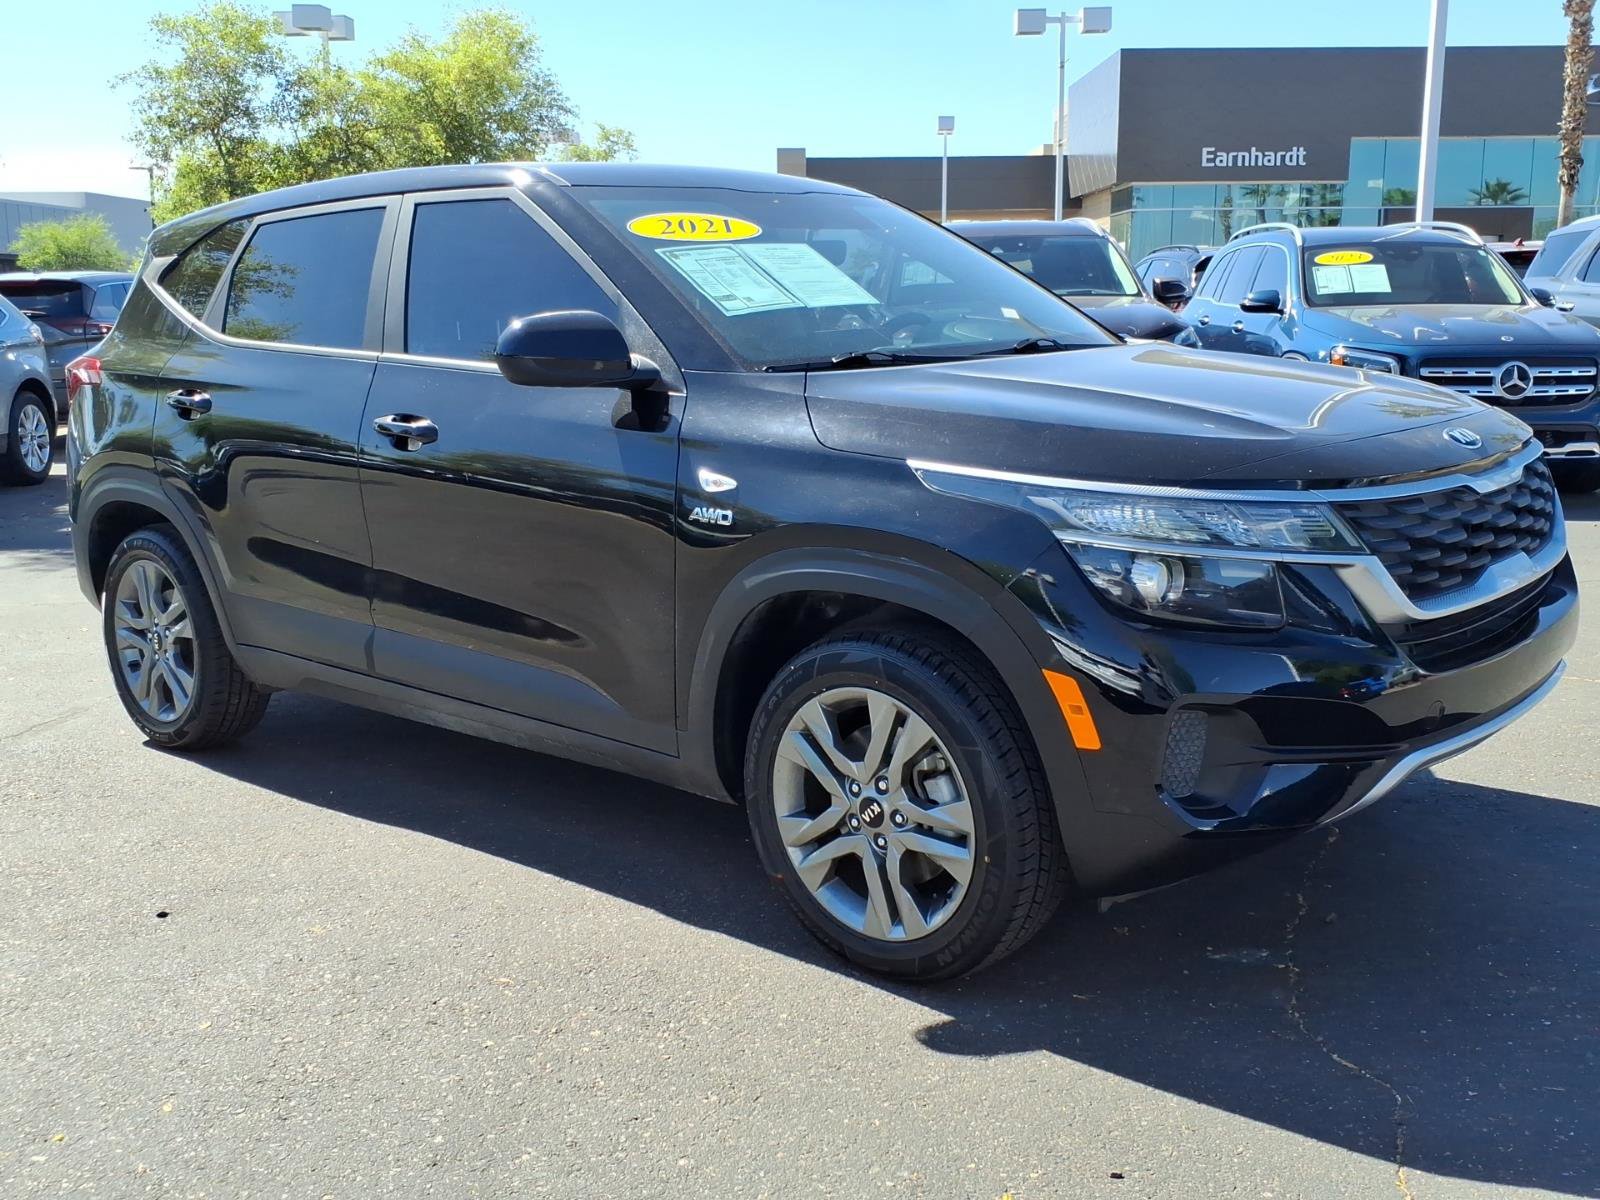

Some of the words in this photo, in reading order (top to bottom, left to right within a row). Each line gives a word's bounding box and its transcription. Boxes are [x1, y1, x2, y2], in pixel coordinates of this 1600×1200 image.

[1201, 146, 1307, 167] Earnhardt
[657, 218, 732, 235] 2021
[688, 506, 733, 526] AWD
[861, 802, 881, 823] KIA
